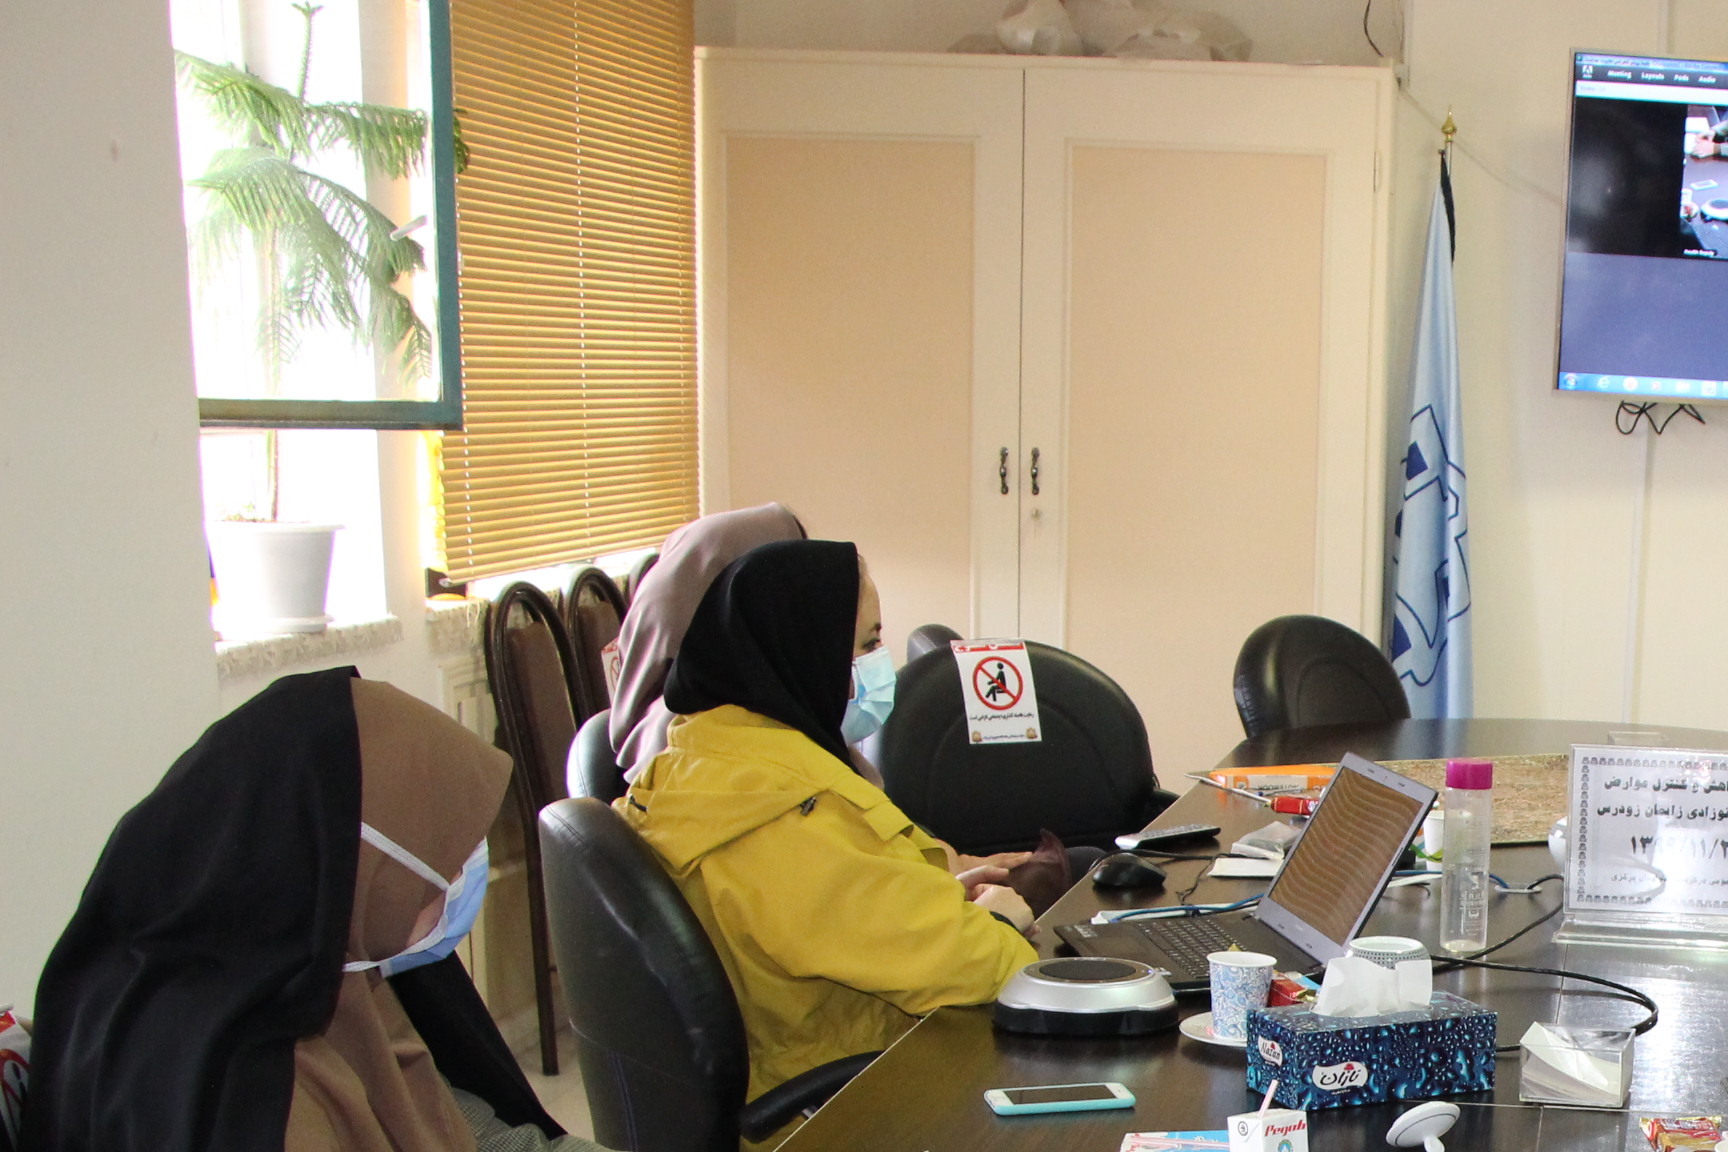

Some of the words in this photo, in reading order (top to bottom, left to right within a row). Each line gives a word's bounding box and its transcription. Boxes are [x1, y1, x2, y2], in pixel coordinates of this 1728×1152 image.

[1607, 69, 1632, 81] Meeting
[1641, 72, 1665, 82] Layouts
[1674, 74, 1689, 83] Pods
[1698, 75, 1716, 84] Audio
[1604, 776, 1649, 790] عوارض
[1597, 804, 1641, 818] زودرس
[1645, 804, 1683, 819] زایمان
[1261, 1041, 1281, 1060] Nazan
[1319, 1068, 1362, 1087] نازان
[1264, 1119, 1307, 1137] Pegah
